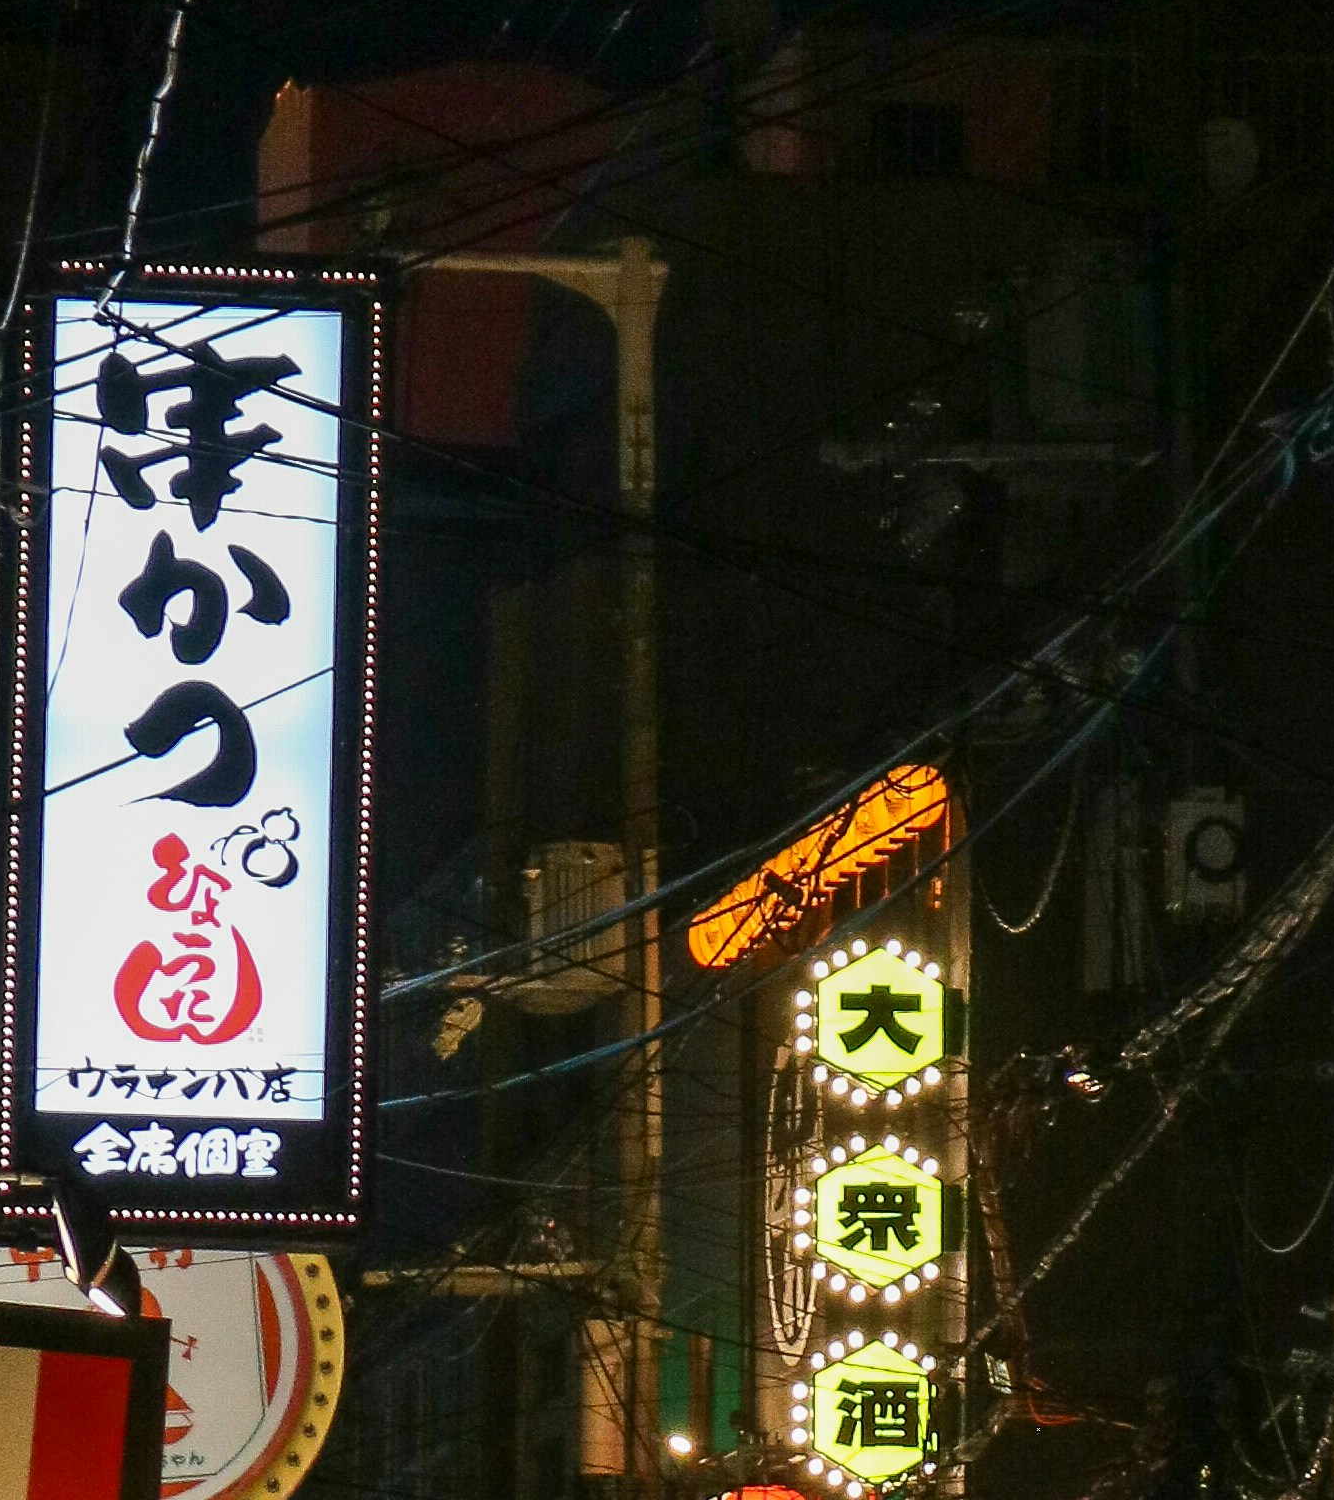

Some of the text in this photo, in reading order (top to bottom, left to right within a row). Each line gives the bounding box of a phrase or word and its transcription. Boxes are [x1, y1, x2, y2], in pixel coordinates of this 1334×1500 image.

[95, 341, 303, 809] 串かつ
[66, 1061, 300, 1106] ウラナンバ店
[71, 1119, 283, 1178] 全席個室
